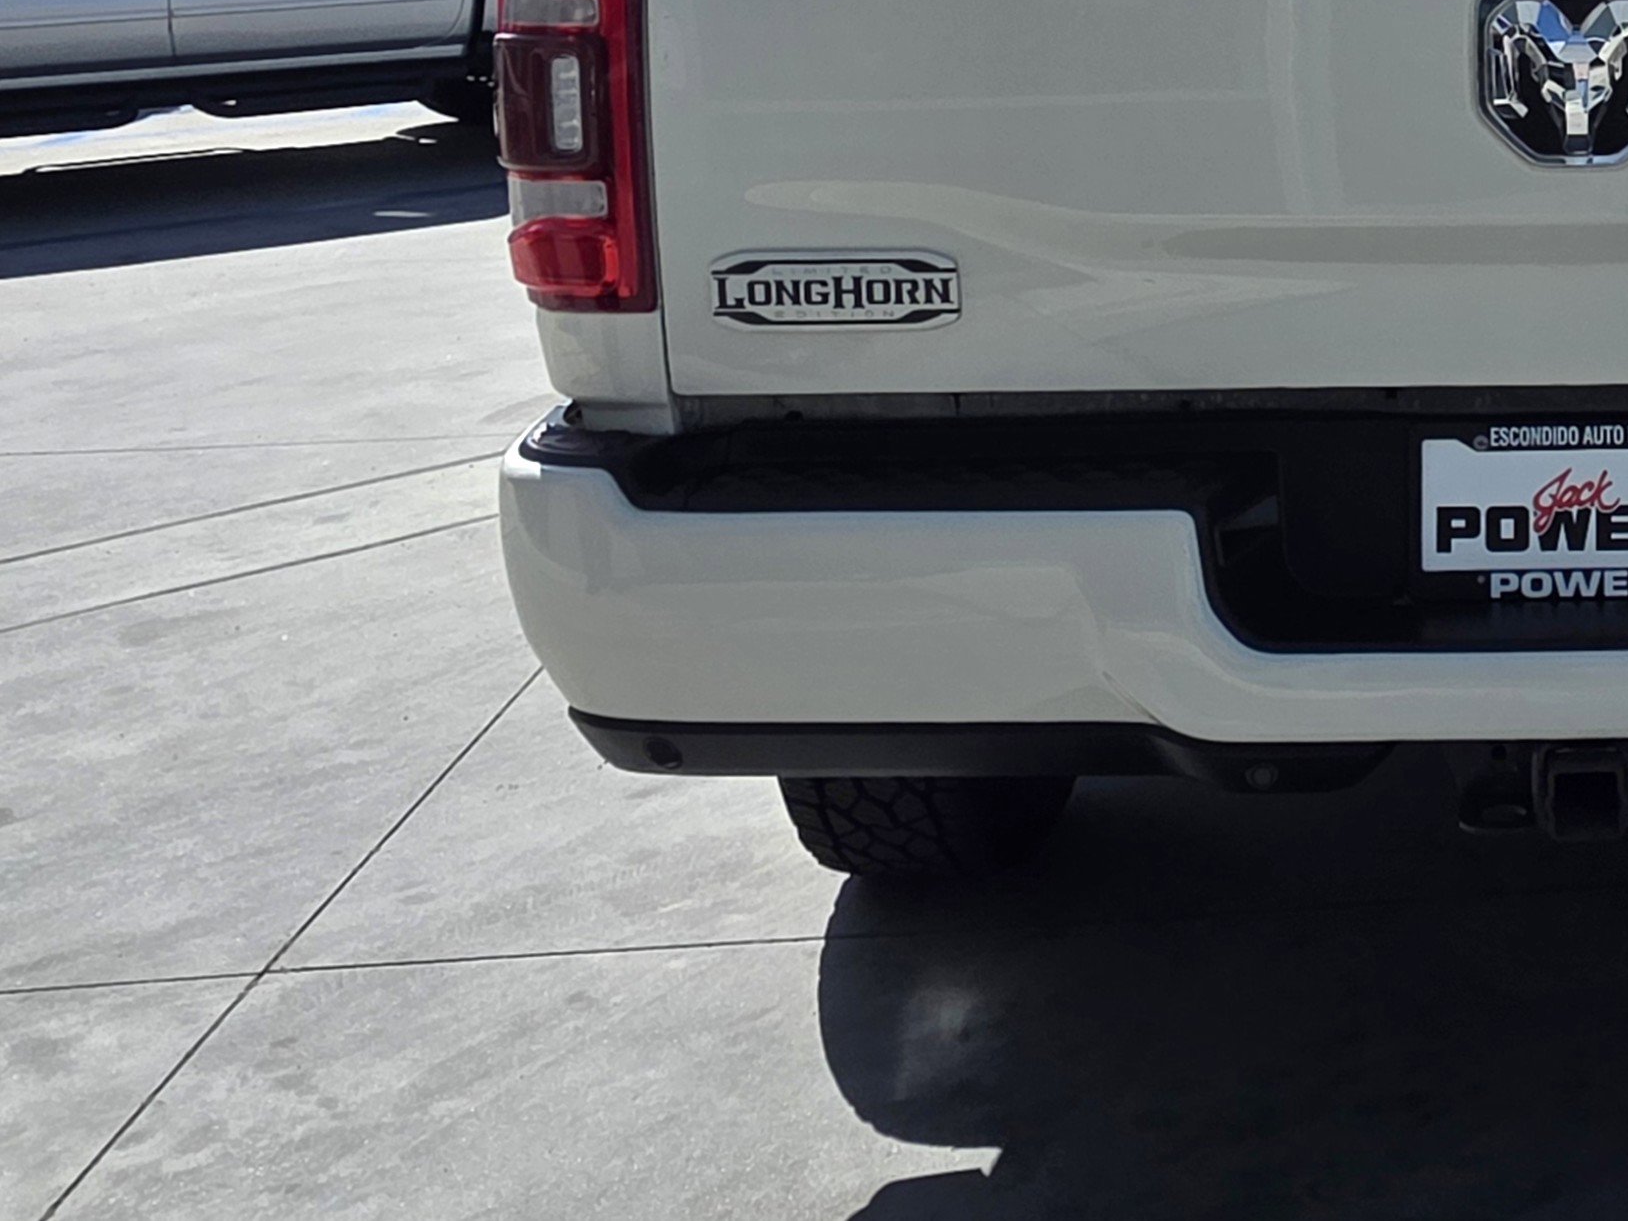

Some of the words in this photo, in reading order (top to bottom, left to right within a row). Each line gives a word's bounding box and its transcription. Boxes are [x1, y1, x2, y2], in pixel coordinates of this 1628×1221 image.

[1490, 426, 1579, 447] ESCONDIDO
[1583, 425, 1623, 446] AUTO
[1532, 467, 1621, 535] Jack
